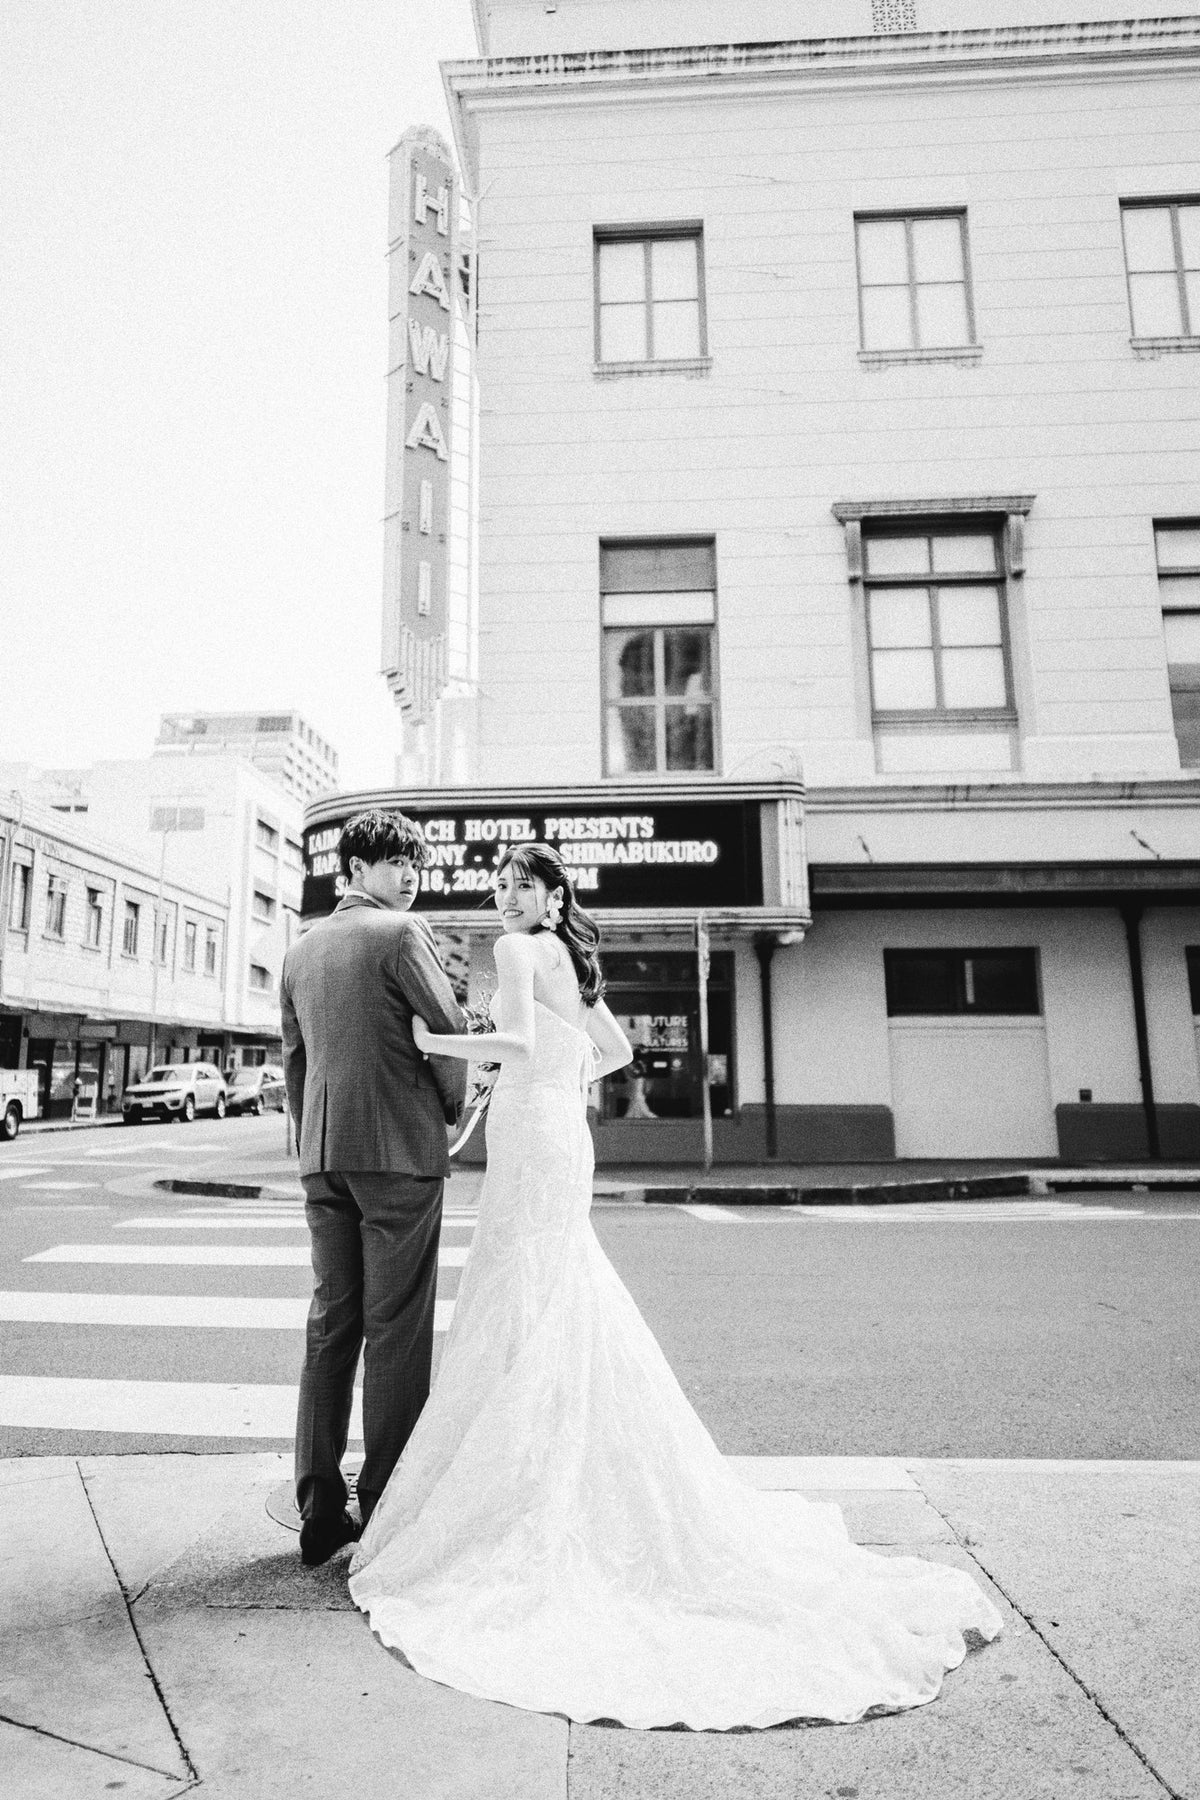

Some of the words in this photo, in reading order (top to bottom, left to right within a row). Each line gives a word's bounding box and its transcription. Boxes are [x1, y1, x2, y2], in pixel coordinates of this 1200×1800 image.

[406, 173, 450, 618] HAWAII
[309, 827, 341, 855] KAIM
[414, 820, 456, 841] ACH
[464, 819, 536, 841] HOTEL
[544, 817, 655, 840] PRESENTS
[559, 841, 718, 864] SHIMABUKURO
